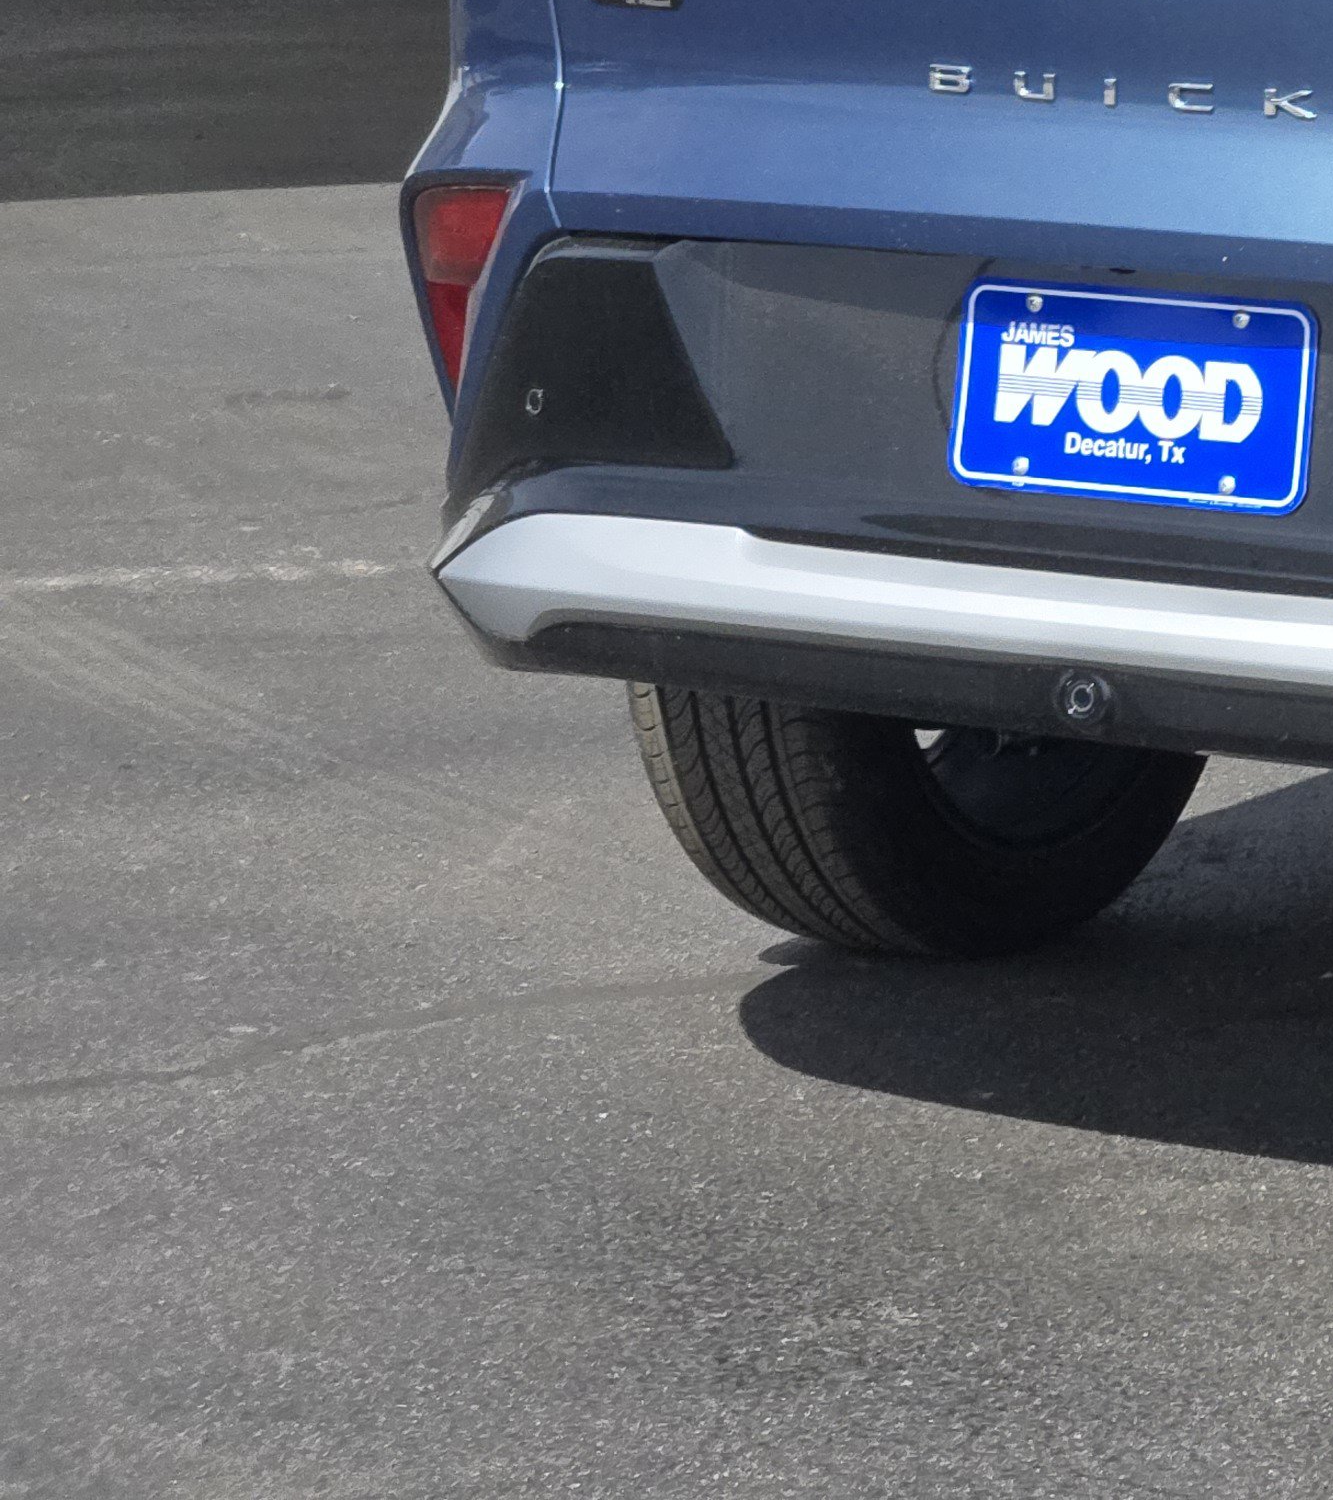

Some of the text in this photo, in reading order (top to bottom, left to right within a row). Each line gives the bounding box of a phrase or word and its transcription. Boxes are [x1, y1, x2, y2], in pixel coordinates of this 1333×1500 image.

[929, 63, 1317, 119] BUICK
[1001, 321, 1075, 349] JAMES
[993, 344, 1263, 444] WOOD
[1064, 432, 1186, 465] Decatur, Tx
